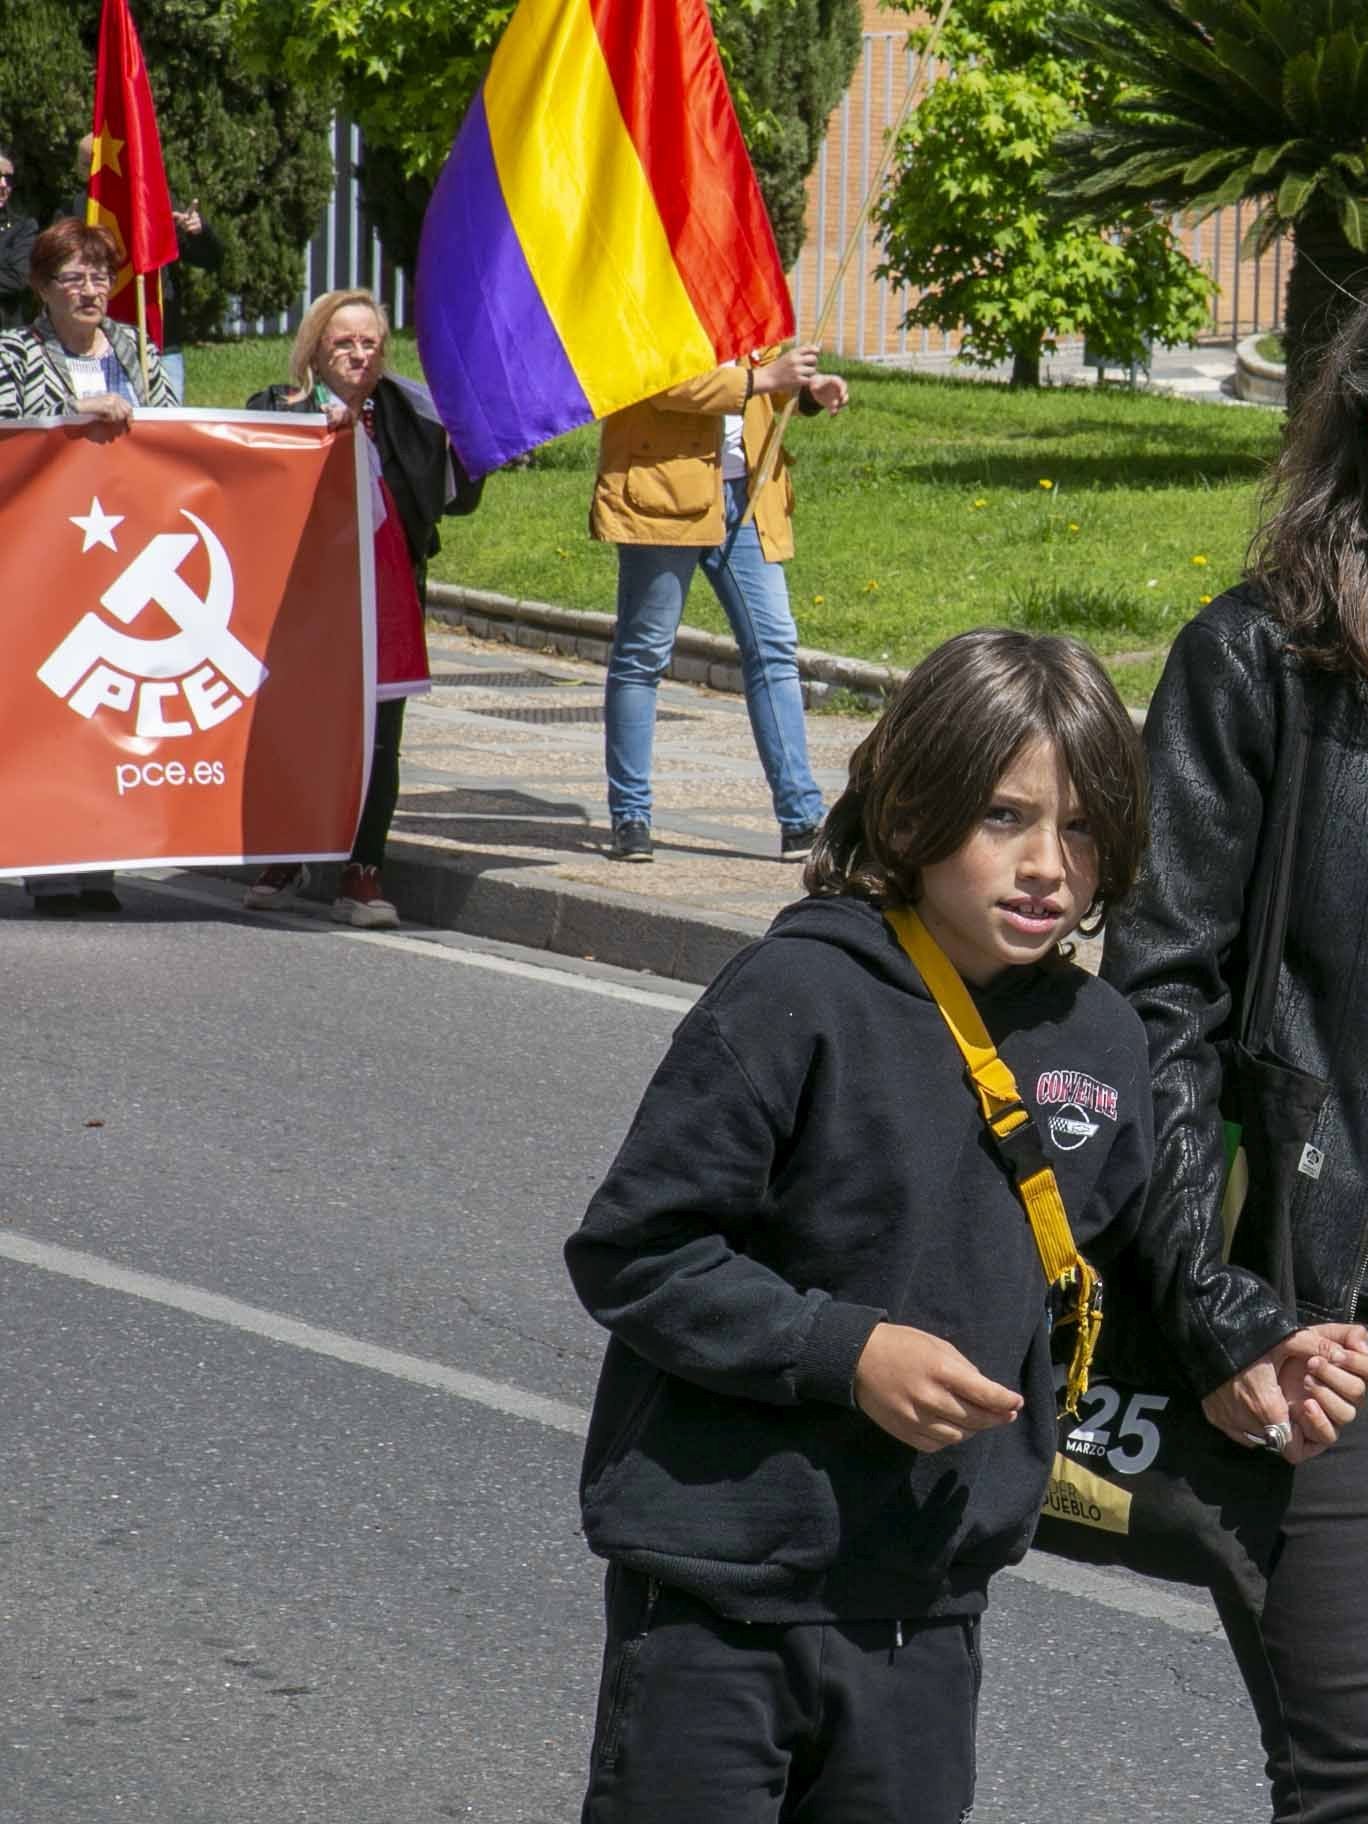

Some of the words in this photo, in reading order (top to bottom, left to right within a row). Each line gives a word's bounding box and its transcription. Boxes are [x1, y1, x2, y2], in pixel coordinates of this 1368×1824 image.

[67, 664, 244, 738] PCE
[115, 760, 225, 796] pce.es
[1036, 1070, 1119, 1122] CORVETTE
[1066, 1438, 1106, 1457] MARZO
[1067, 1384, 1170, 1475] 25
[1044, 1494, 1102, 1521] UEBLO
